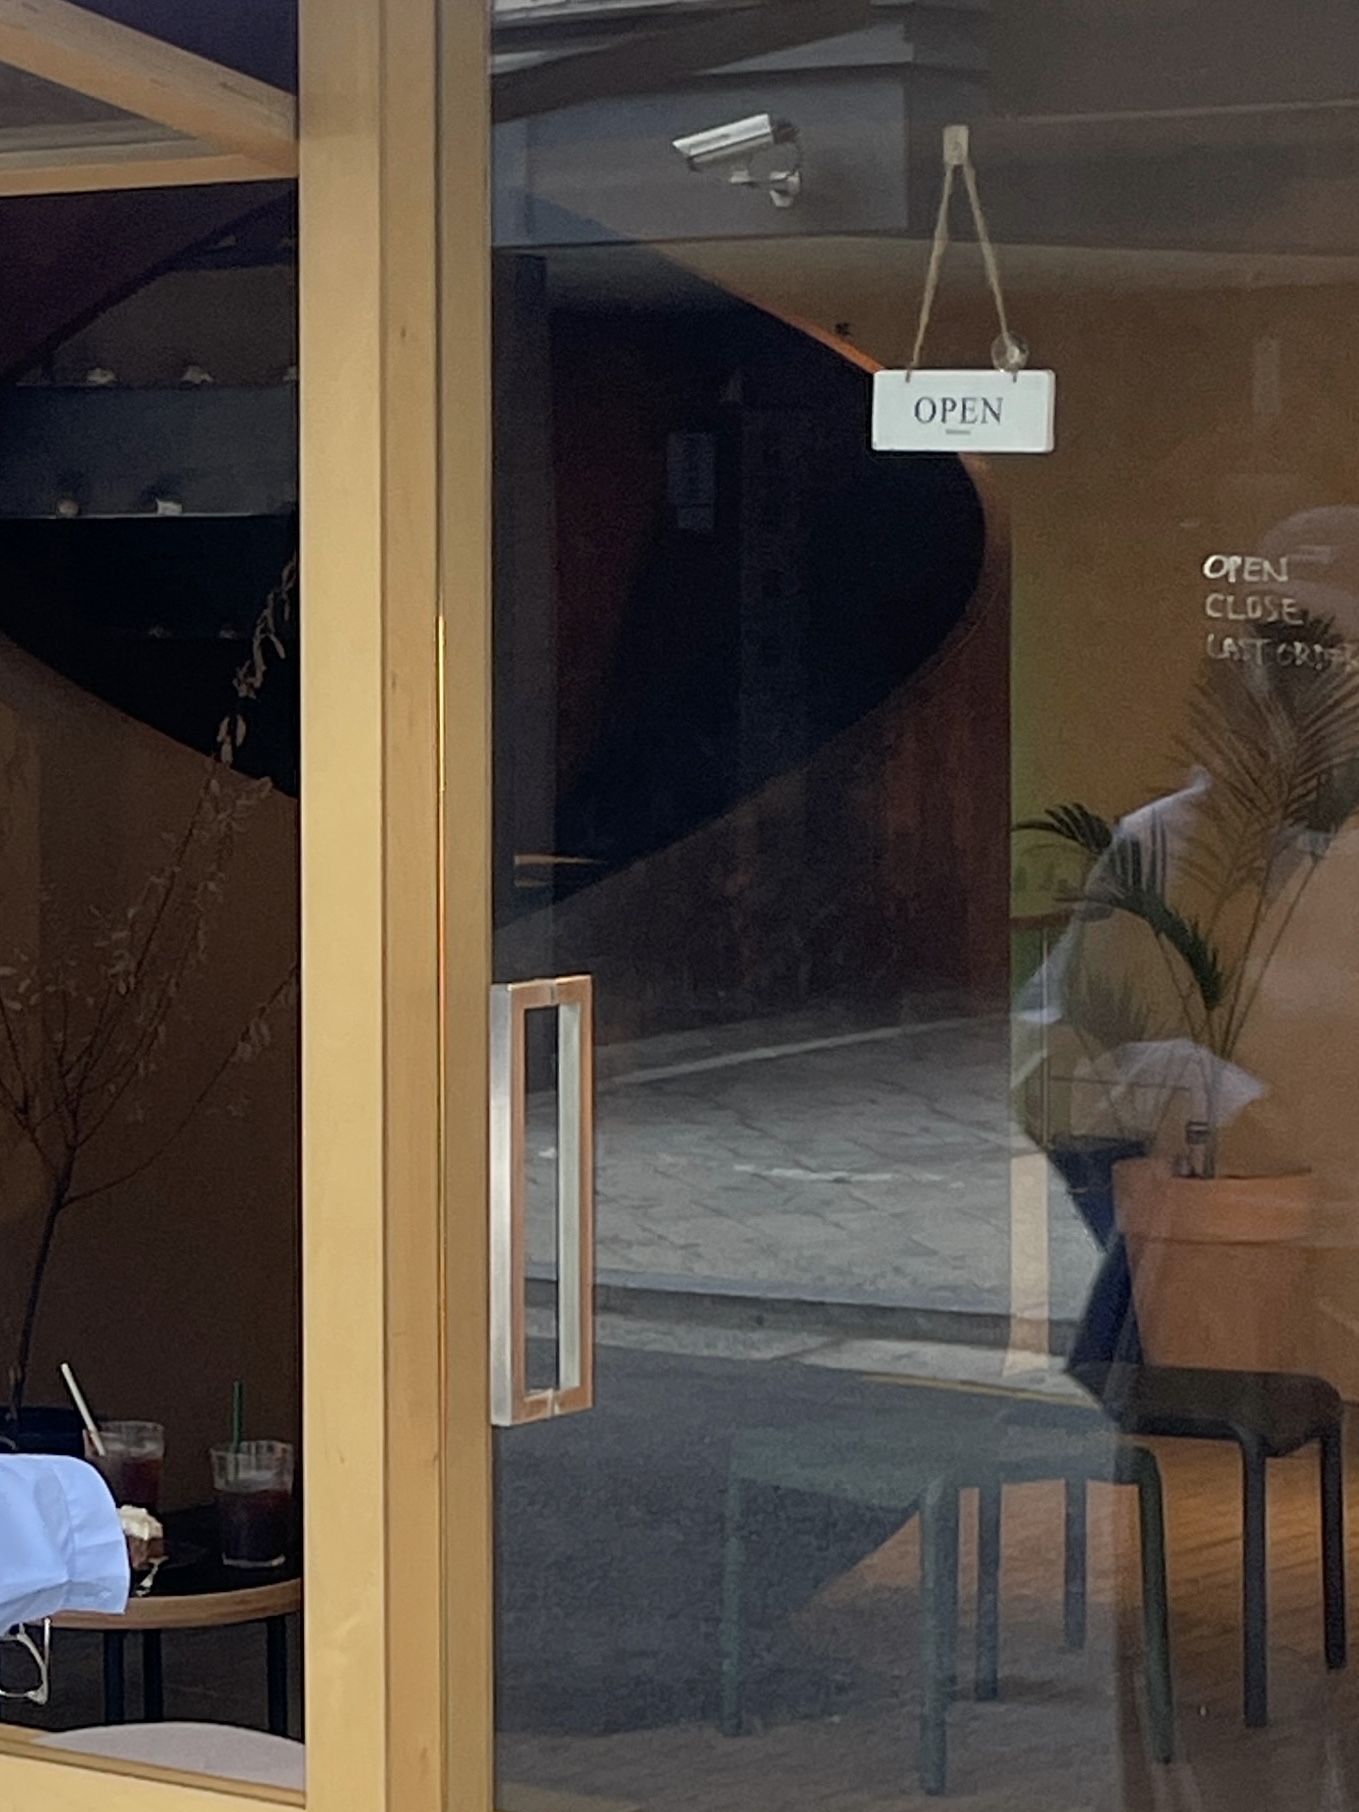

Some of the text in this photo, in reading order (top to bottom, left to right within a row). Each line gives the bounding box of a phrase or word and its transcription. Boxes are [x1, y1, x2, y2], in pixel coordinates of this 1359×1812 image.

[913, 395, 1004, 424] OPEN
[1202, 554, 1289, 583] OPEN
[1205, 593, 1305, 626] CLOSE
[1206, 633, 1272, 666] LAST
